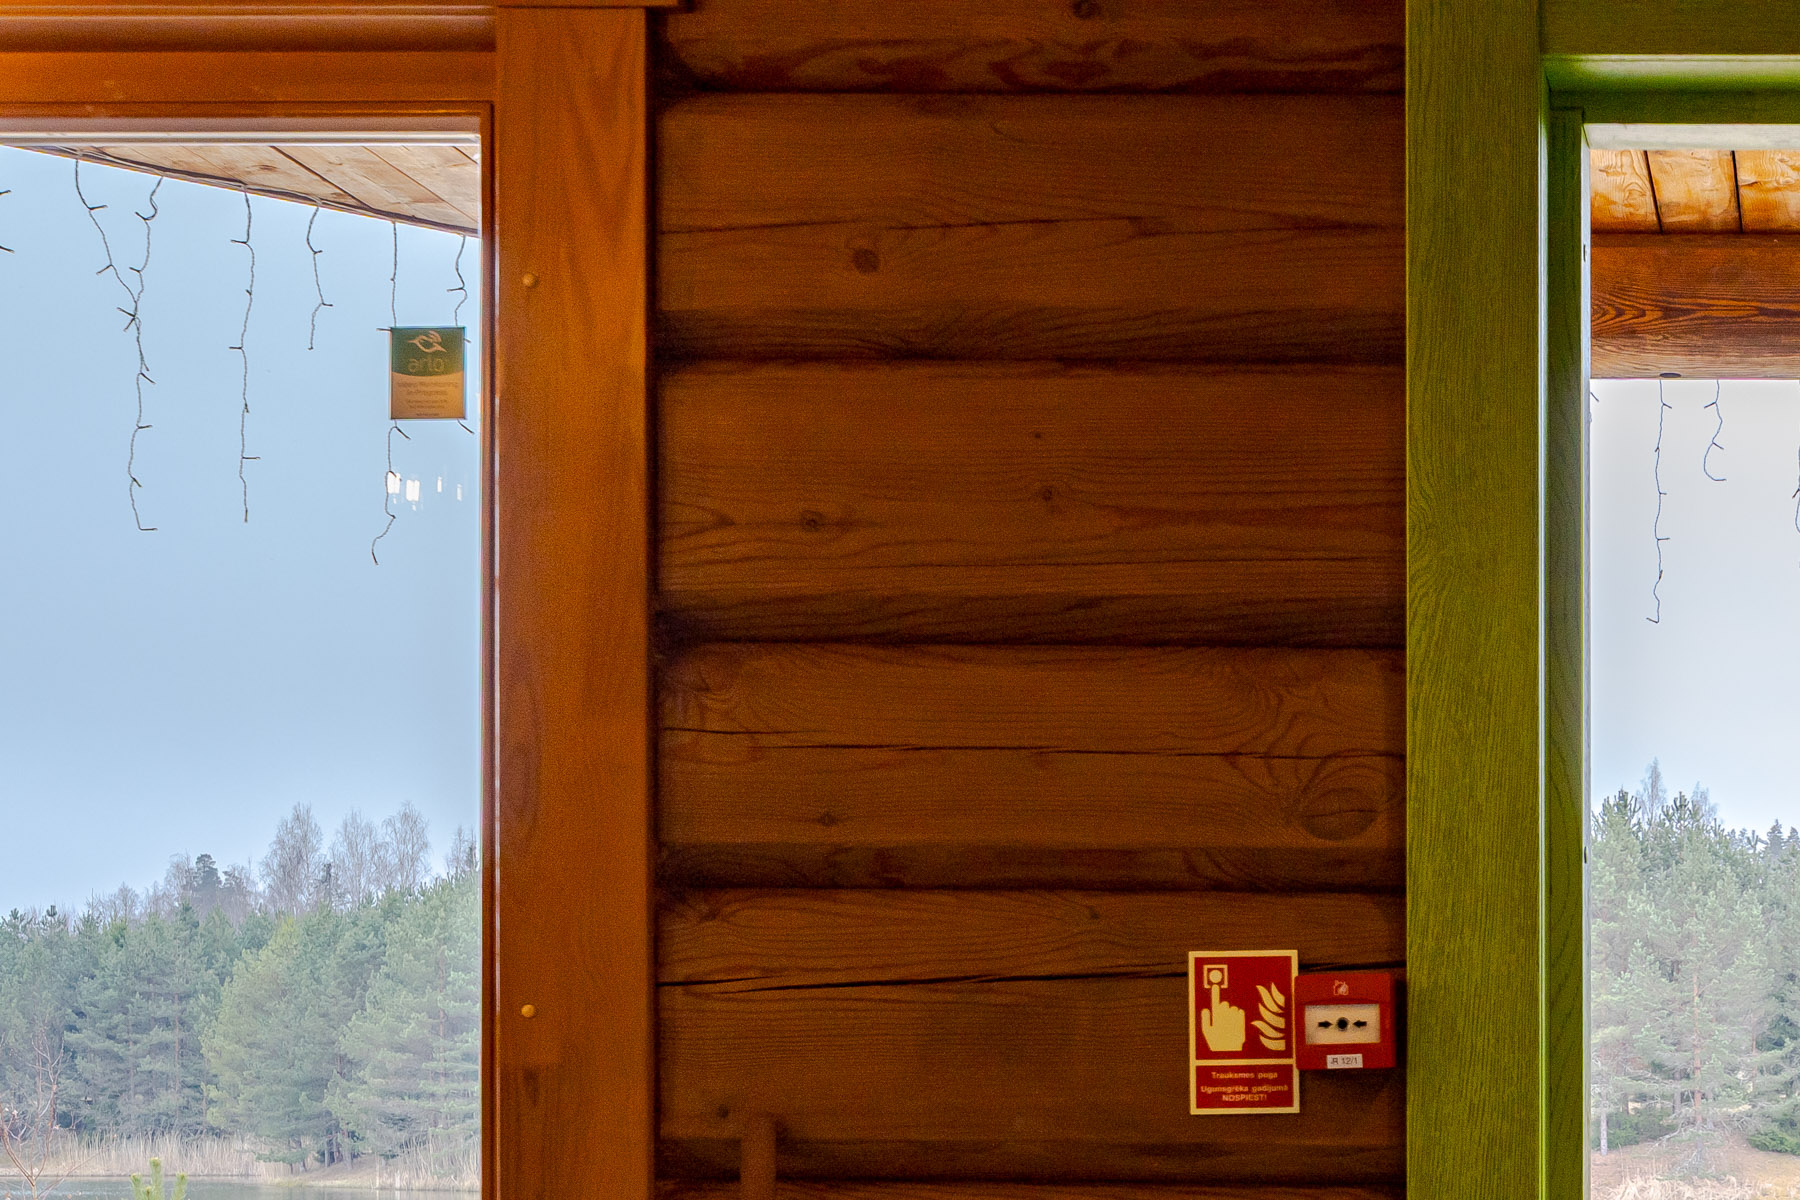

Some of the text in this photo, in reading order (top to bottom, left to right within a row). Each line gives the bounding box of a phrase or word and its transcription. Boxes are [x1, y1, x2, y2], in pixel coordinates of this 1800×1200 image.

[407, 354, 445, 373] arlo
[1342, 1056, 1358, 1065] 12/1
[1210, 1071, 1278, 1080] Trauksmes poga
[1222, 1093, 1267, 1102] NOSPIEST!
